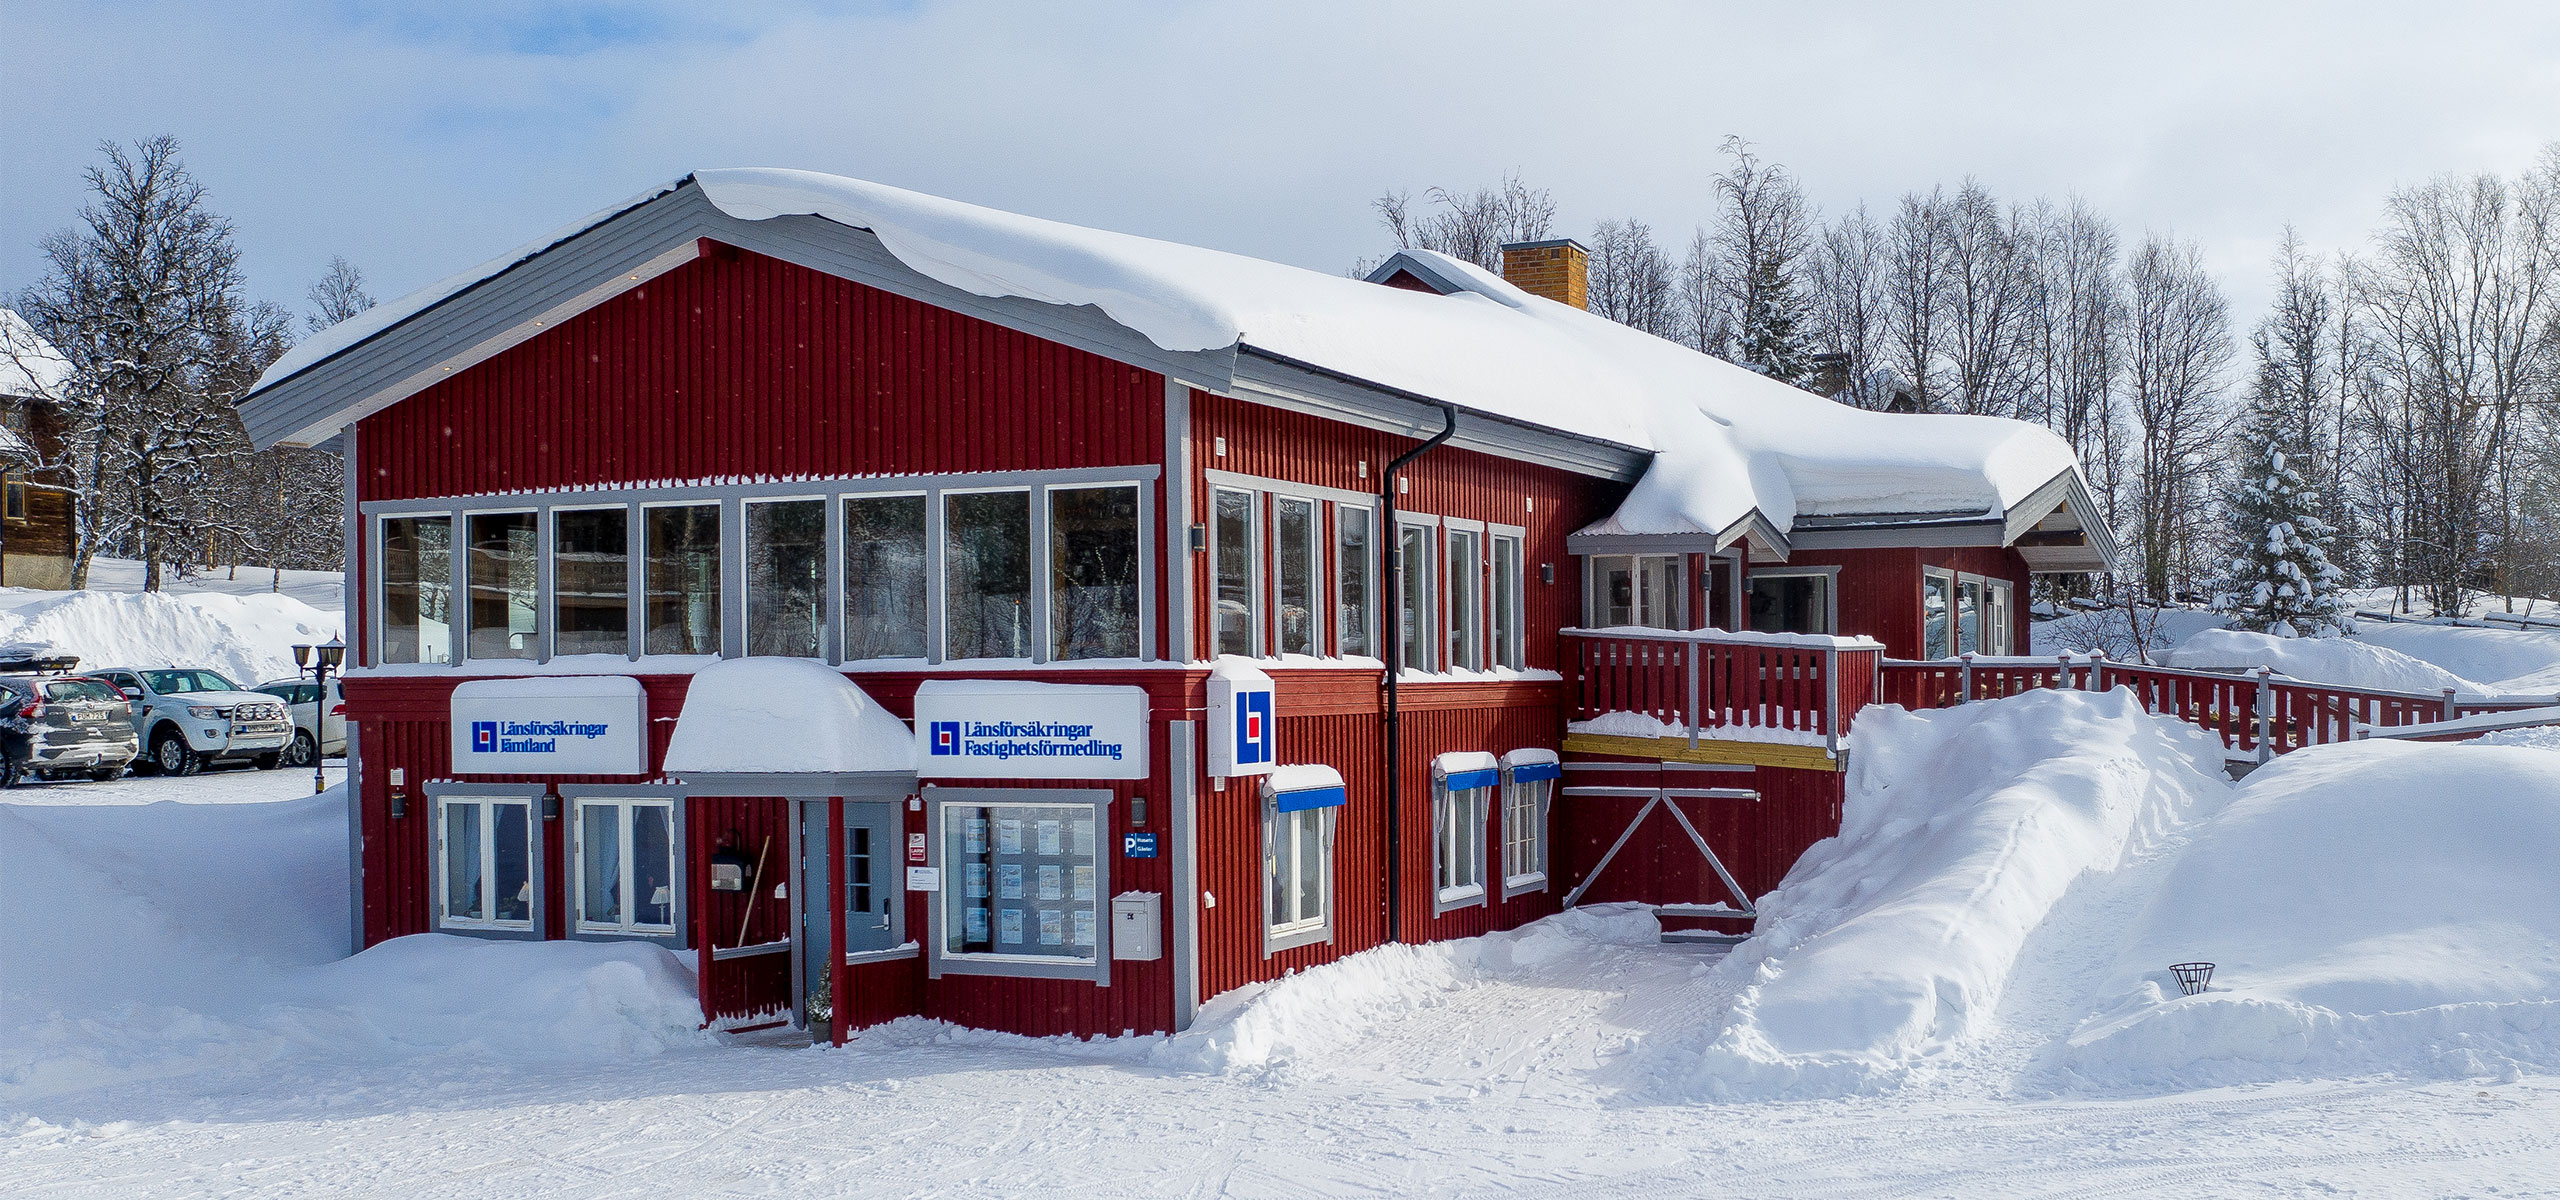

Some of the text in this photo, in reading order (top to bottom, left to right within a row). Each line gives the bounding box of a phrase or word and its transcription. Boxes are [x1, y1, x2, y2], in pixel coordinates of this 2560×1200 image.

[500, 720, 608, 739] Länsförsäkringar
[964, 720, 1093, 741] Länsförsäkringar
[500, 738, 556, 753] Jämtland
[964, 740, 1123, 760] Fastighetsförmedling
[1125, 837, 1136, 853] P
